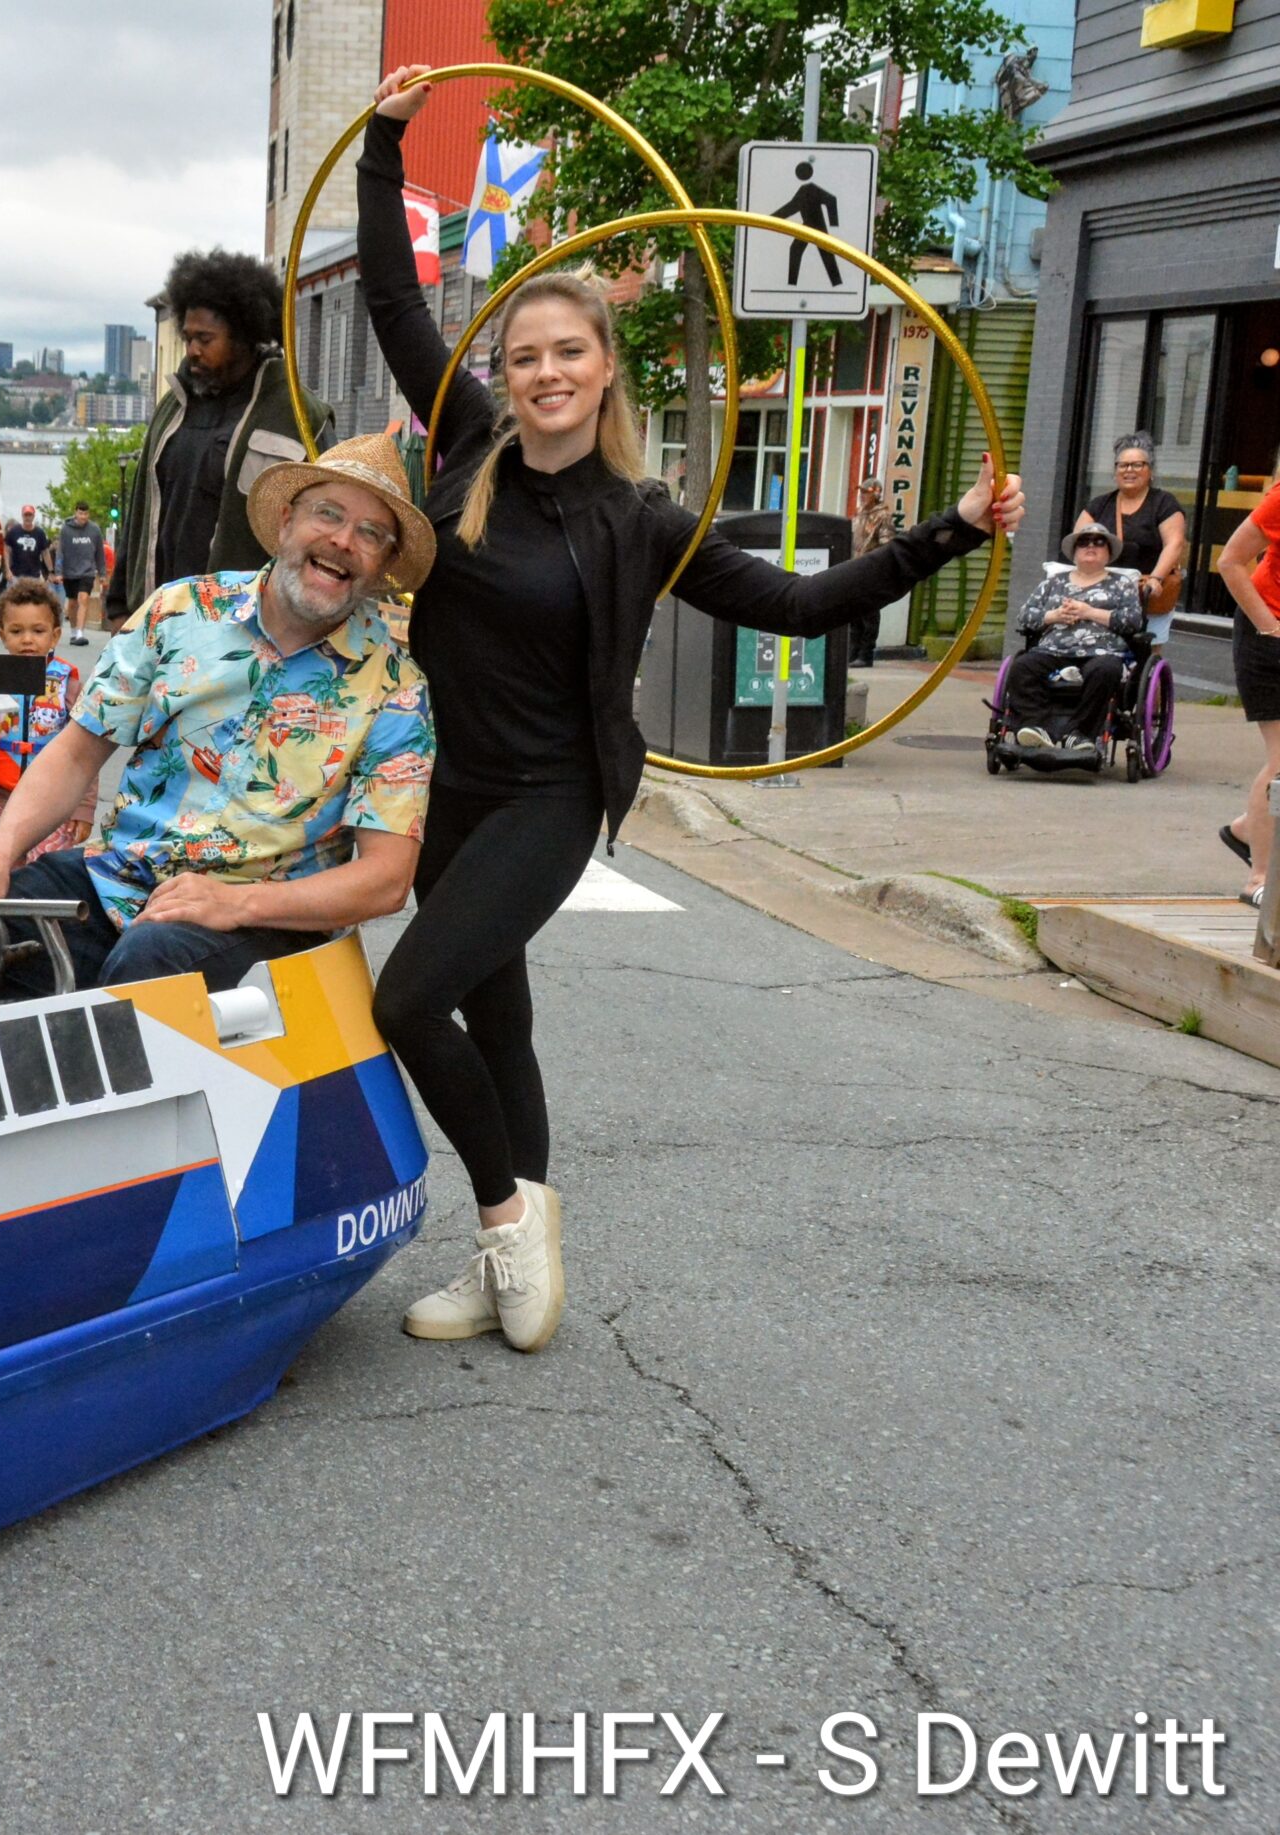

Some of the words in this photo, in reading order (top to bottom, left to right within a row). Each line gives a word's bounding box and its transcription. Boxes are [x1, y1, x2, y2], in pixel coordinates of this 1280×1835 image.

[903, 325, 929, 339] 1975
[894, 366, 921, 468] REVANA
[793, 557, 821, 567] ecycle
